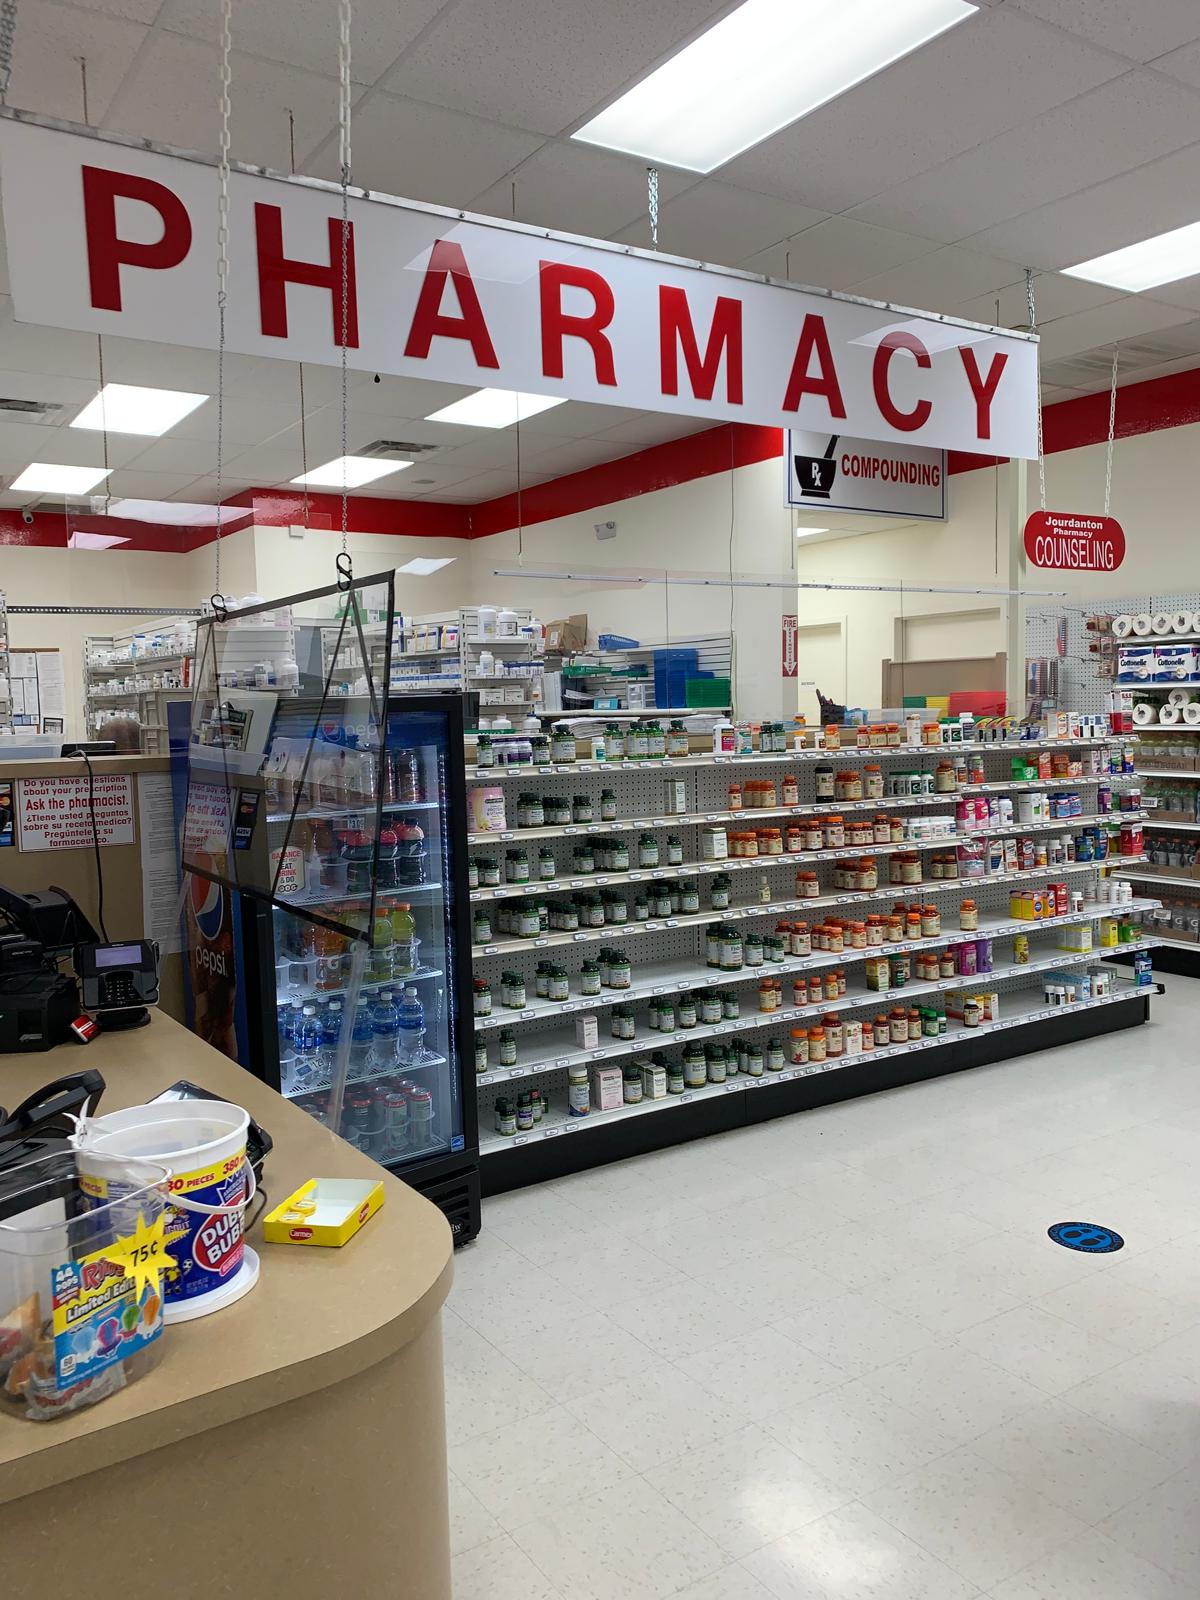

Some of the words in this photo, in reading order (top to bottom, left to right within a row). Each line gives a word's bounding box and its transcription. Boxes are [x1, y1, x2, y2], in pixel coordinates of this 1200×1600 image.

[82, 164, 1008, 440] PHARMACY
[841, 454, 941, 488] COMPOUNDING
[1045, 516, 1103, 530] Jourdanton
[1053, 528, 1093, 539] Pharmacy
[1035, 535, 1114, 569] COUNSELING
[783, 619, 797, 628] FIRE
[1120, 658, 1147, 667] Cottonelle
[1157, 657, 1185, 666] Cottonelle
[344, 720, 392, 741] pepi
[59, 778, 80, 786] have
[83, 776, 126, 786] qestions
[23, 788, 49, 796] about
[52, 787, 72, 796] your
[75, 784, 128, 795] precription
[25, 798, 46, 811] Ask
[48, 797, 65, 809] the
[69, 795, 129, 811] phamacist.
[59, 811, 83, 820] usted
[86, 809, 129, 820] peguntas
[23, 823, 49, 831] sobre
[49, 837, 110, 847] farmaceutco.
[271, 850, 301, 861] BAANCE
[195, 945, 227, 977] pepsi
[186, 1173, 216, 1188] PIECES
[130, 1241, 158, 1267] 75¢
[55, 1267, 74, 1282] 44
[55, 1276, 79, 1292] POPS
[66, 1290, 111, 1324] Limited
